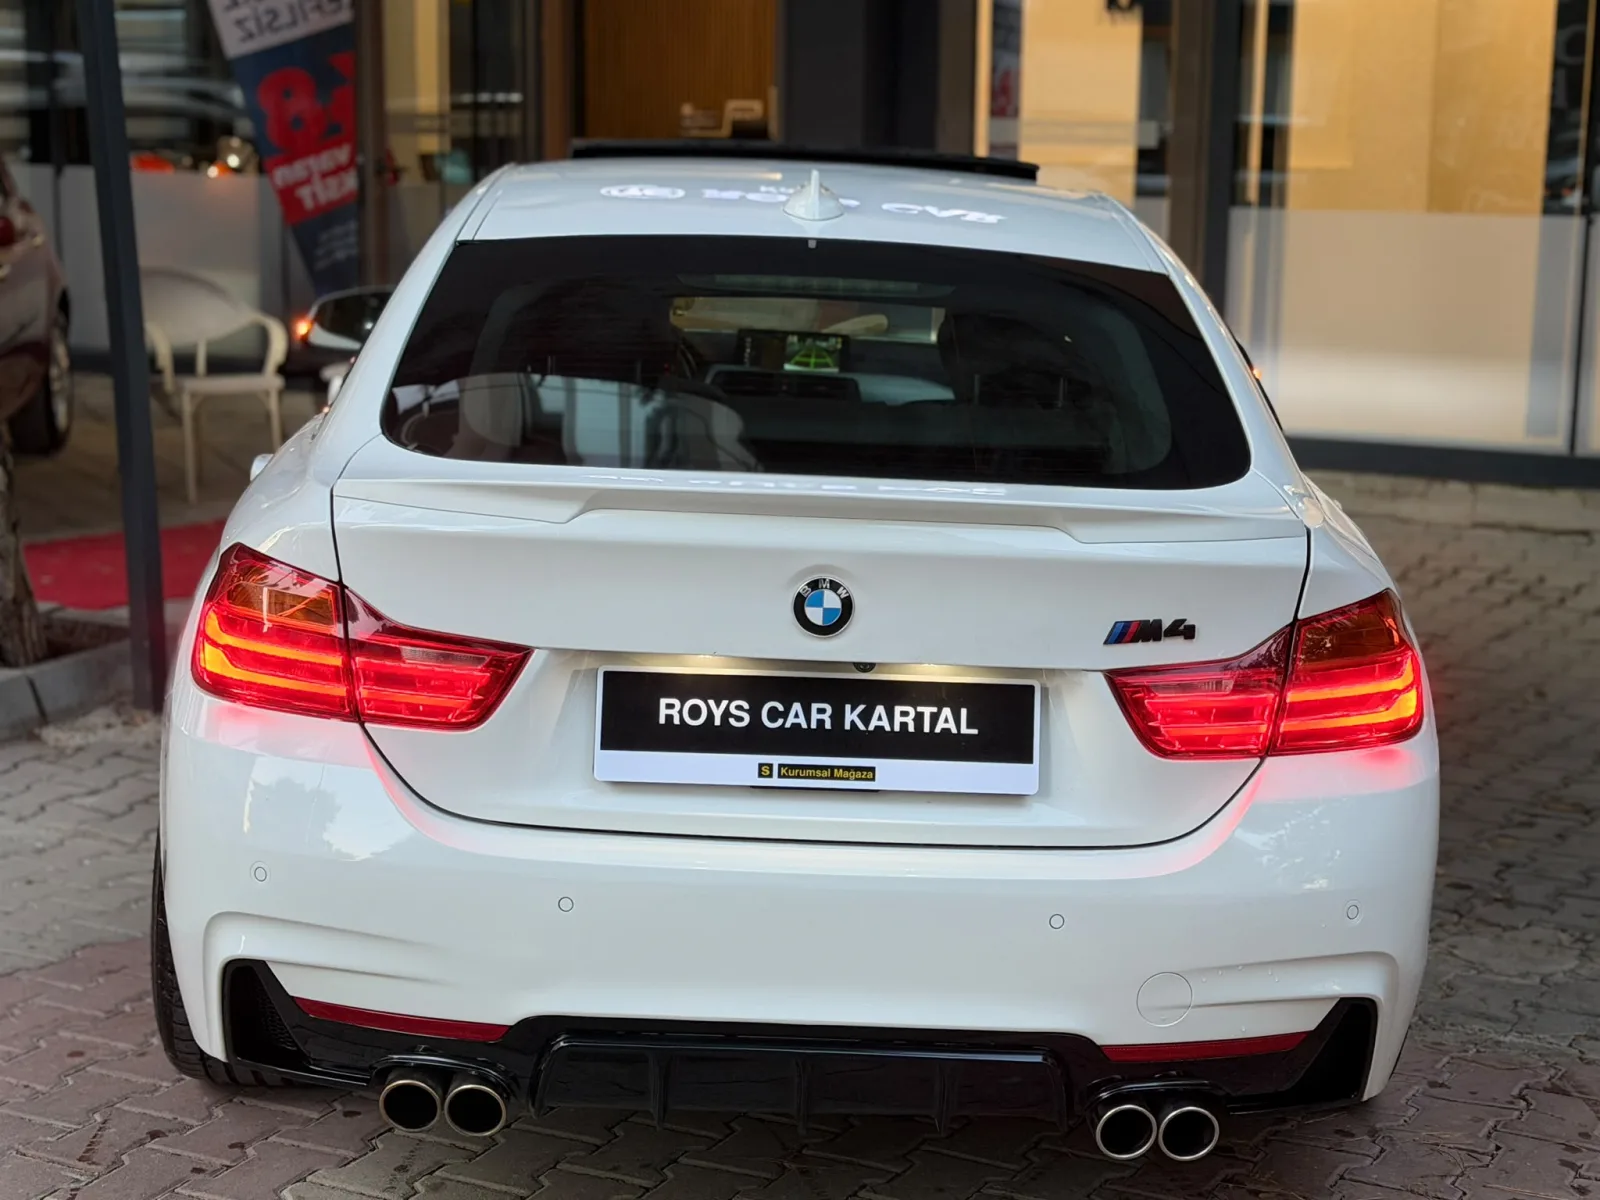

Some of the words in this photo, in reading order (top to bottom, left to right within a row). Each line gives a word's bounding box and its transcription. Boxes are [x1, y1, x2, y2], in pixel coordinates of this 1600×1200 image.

[799, 578, 850, 599] BMW
[1125, 618, 1196, 644] M4
[658, 697, 751, 728] ROYS
[761, 701, 832, 730] CAR
[843, 704, 979, 735] KARTAL
[780, 767, 831, 778] Kurumsal
[833, 768, 873, 781] Mağaza
